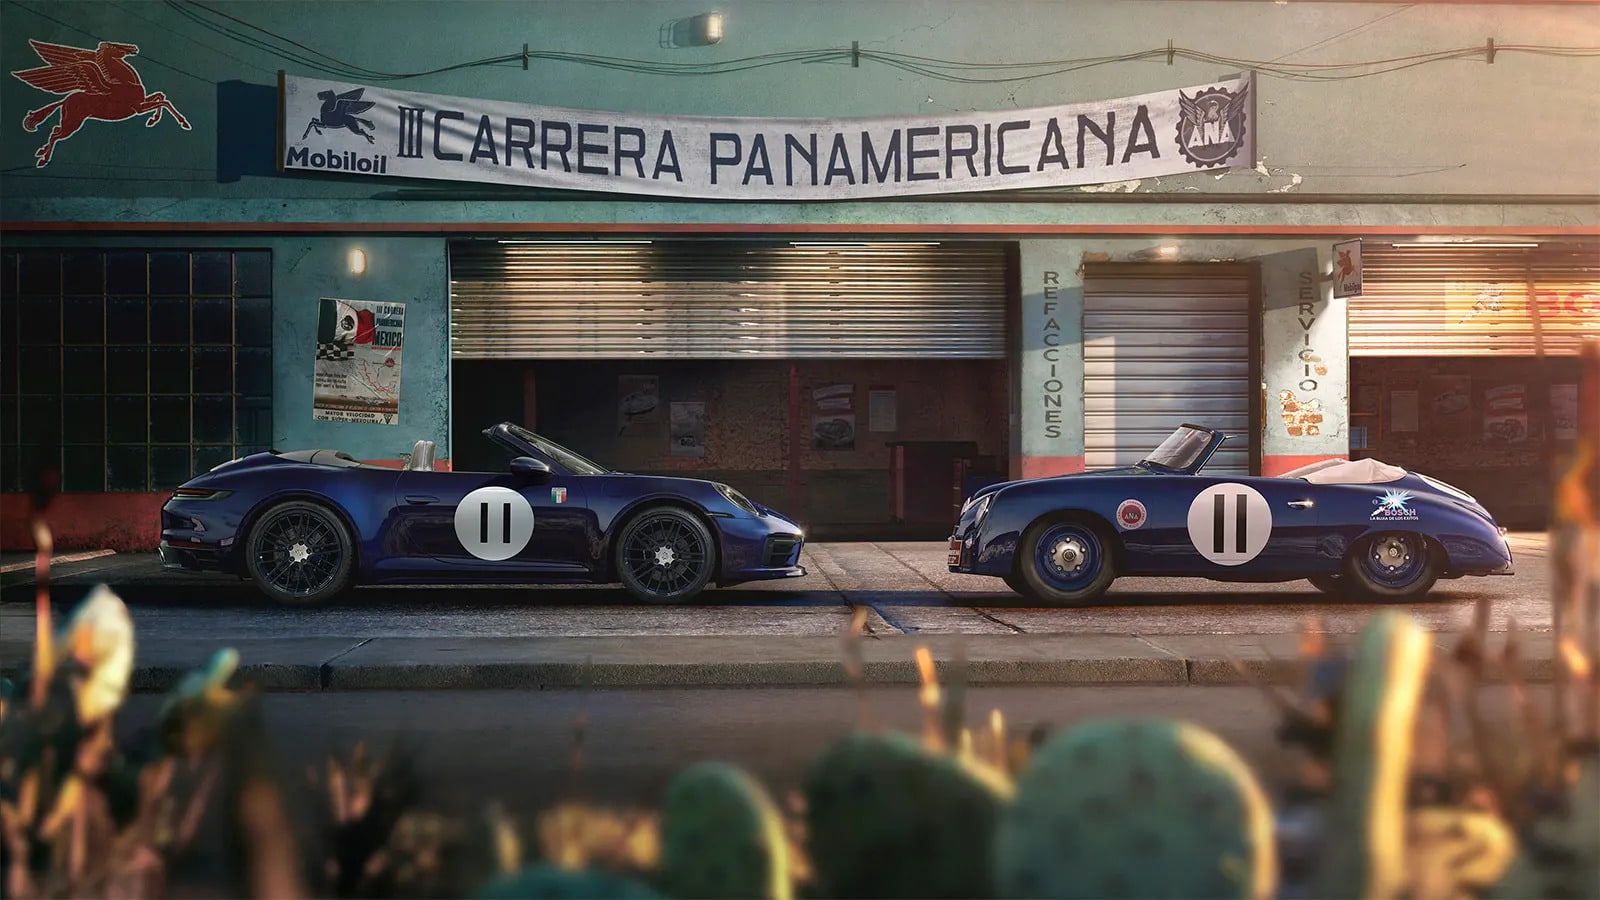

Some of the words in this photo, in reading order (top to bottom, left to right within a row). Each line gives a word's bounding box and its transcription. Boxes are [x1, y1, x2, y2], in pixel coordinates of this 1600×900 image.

[433, 110, 683, 182] CARRERA
[710, 105, 1160, 187] PANAMERICANA
[1188, 120, 1236, 148] ANA
[286, 146, 387, 174] Mobiloil
[372, 330, 402, 346] MEXICO
[1297, 271, 1318, 392] SERVICIO
[1043, 271, 1063, 439] REFACCIONES
[480, 503, 511, 543] 11
[1213, 494, 1248, 553] 11
[1384, 508, 1416, 516] BOSCH
